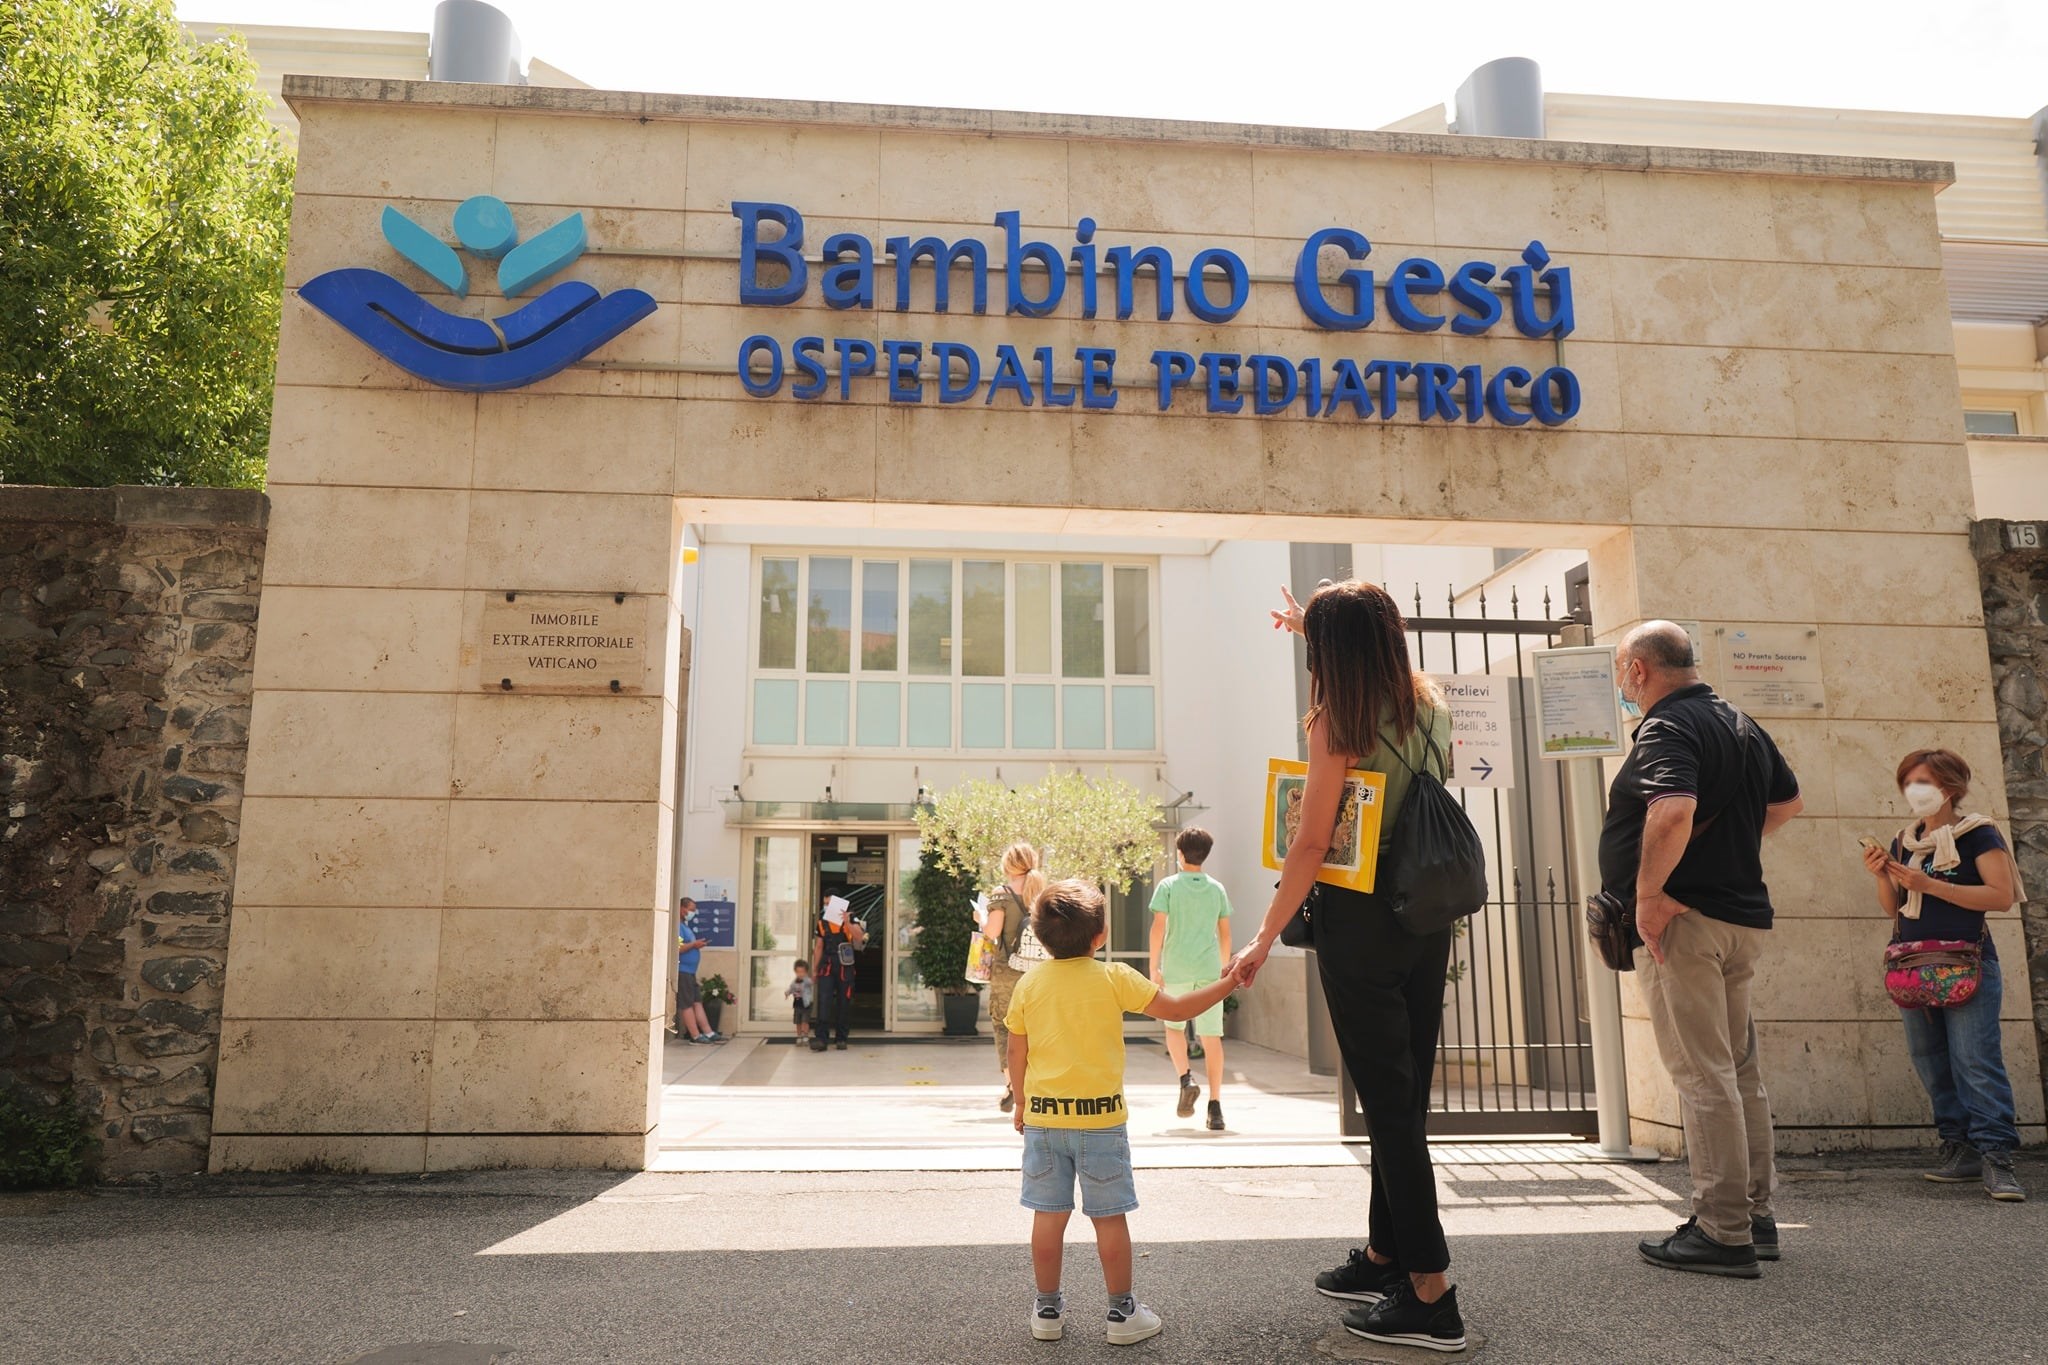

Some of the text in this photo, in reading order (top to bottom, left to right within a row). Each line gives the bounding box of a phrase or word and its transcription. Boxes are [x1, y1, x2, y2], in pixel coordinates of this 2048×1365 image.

[731, 200, 1576, 340] Bambino Gesù
[737, 334, 1582, 427] OSPEDALE PEDIATRICO
[2012, 526, 2036, 546] 15
[531, 613, 599, 626] IMMOBILE
[493, 634, 634, 649] EXTRATERRITORIALE
[528, 656, 597, 669] VATICANO
[1733, 652, 1746, 660] NO
[1444, 684, 1490, 697] Prelievi
[1452, 721, 1497, 733] ldelli, 38
[1030, 1093, 1123, 1115] BATMAN
